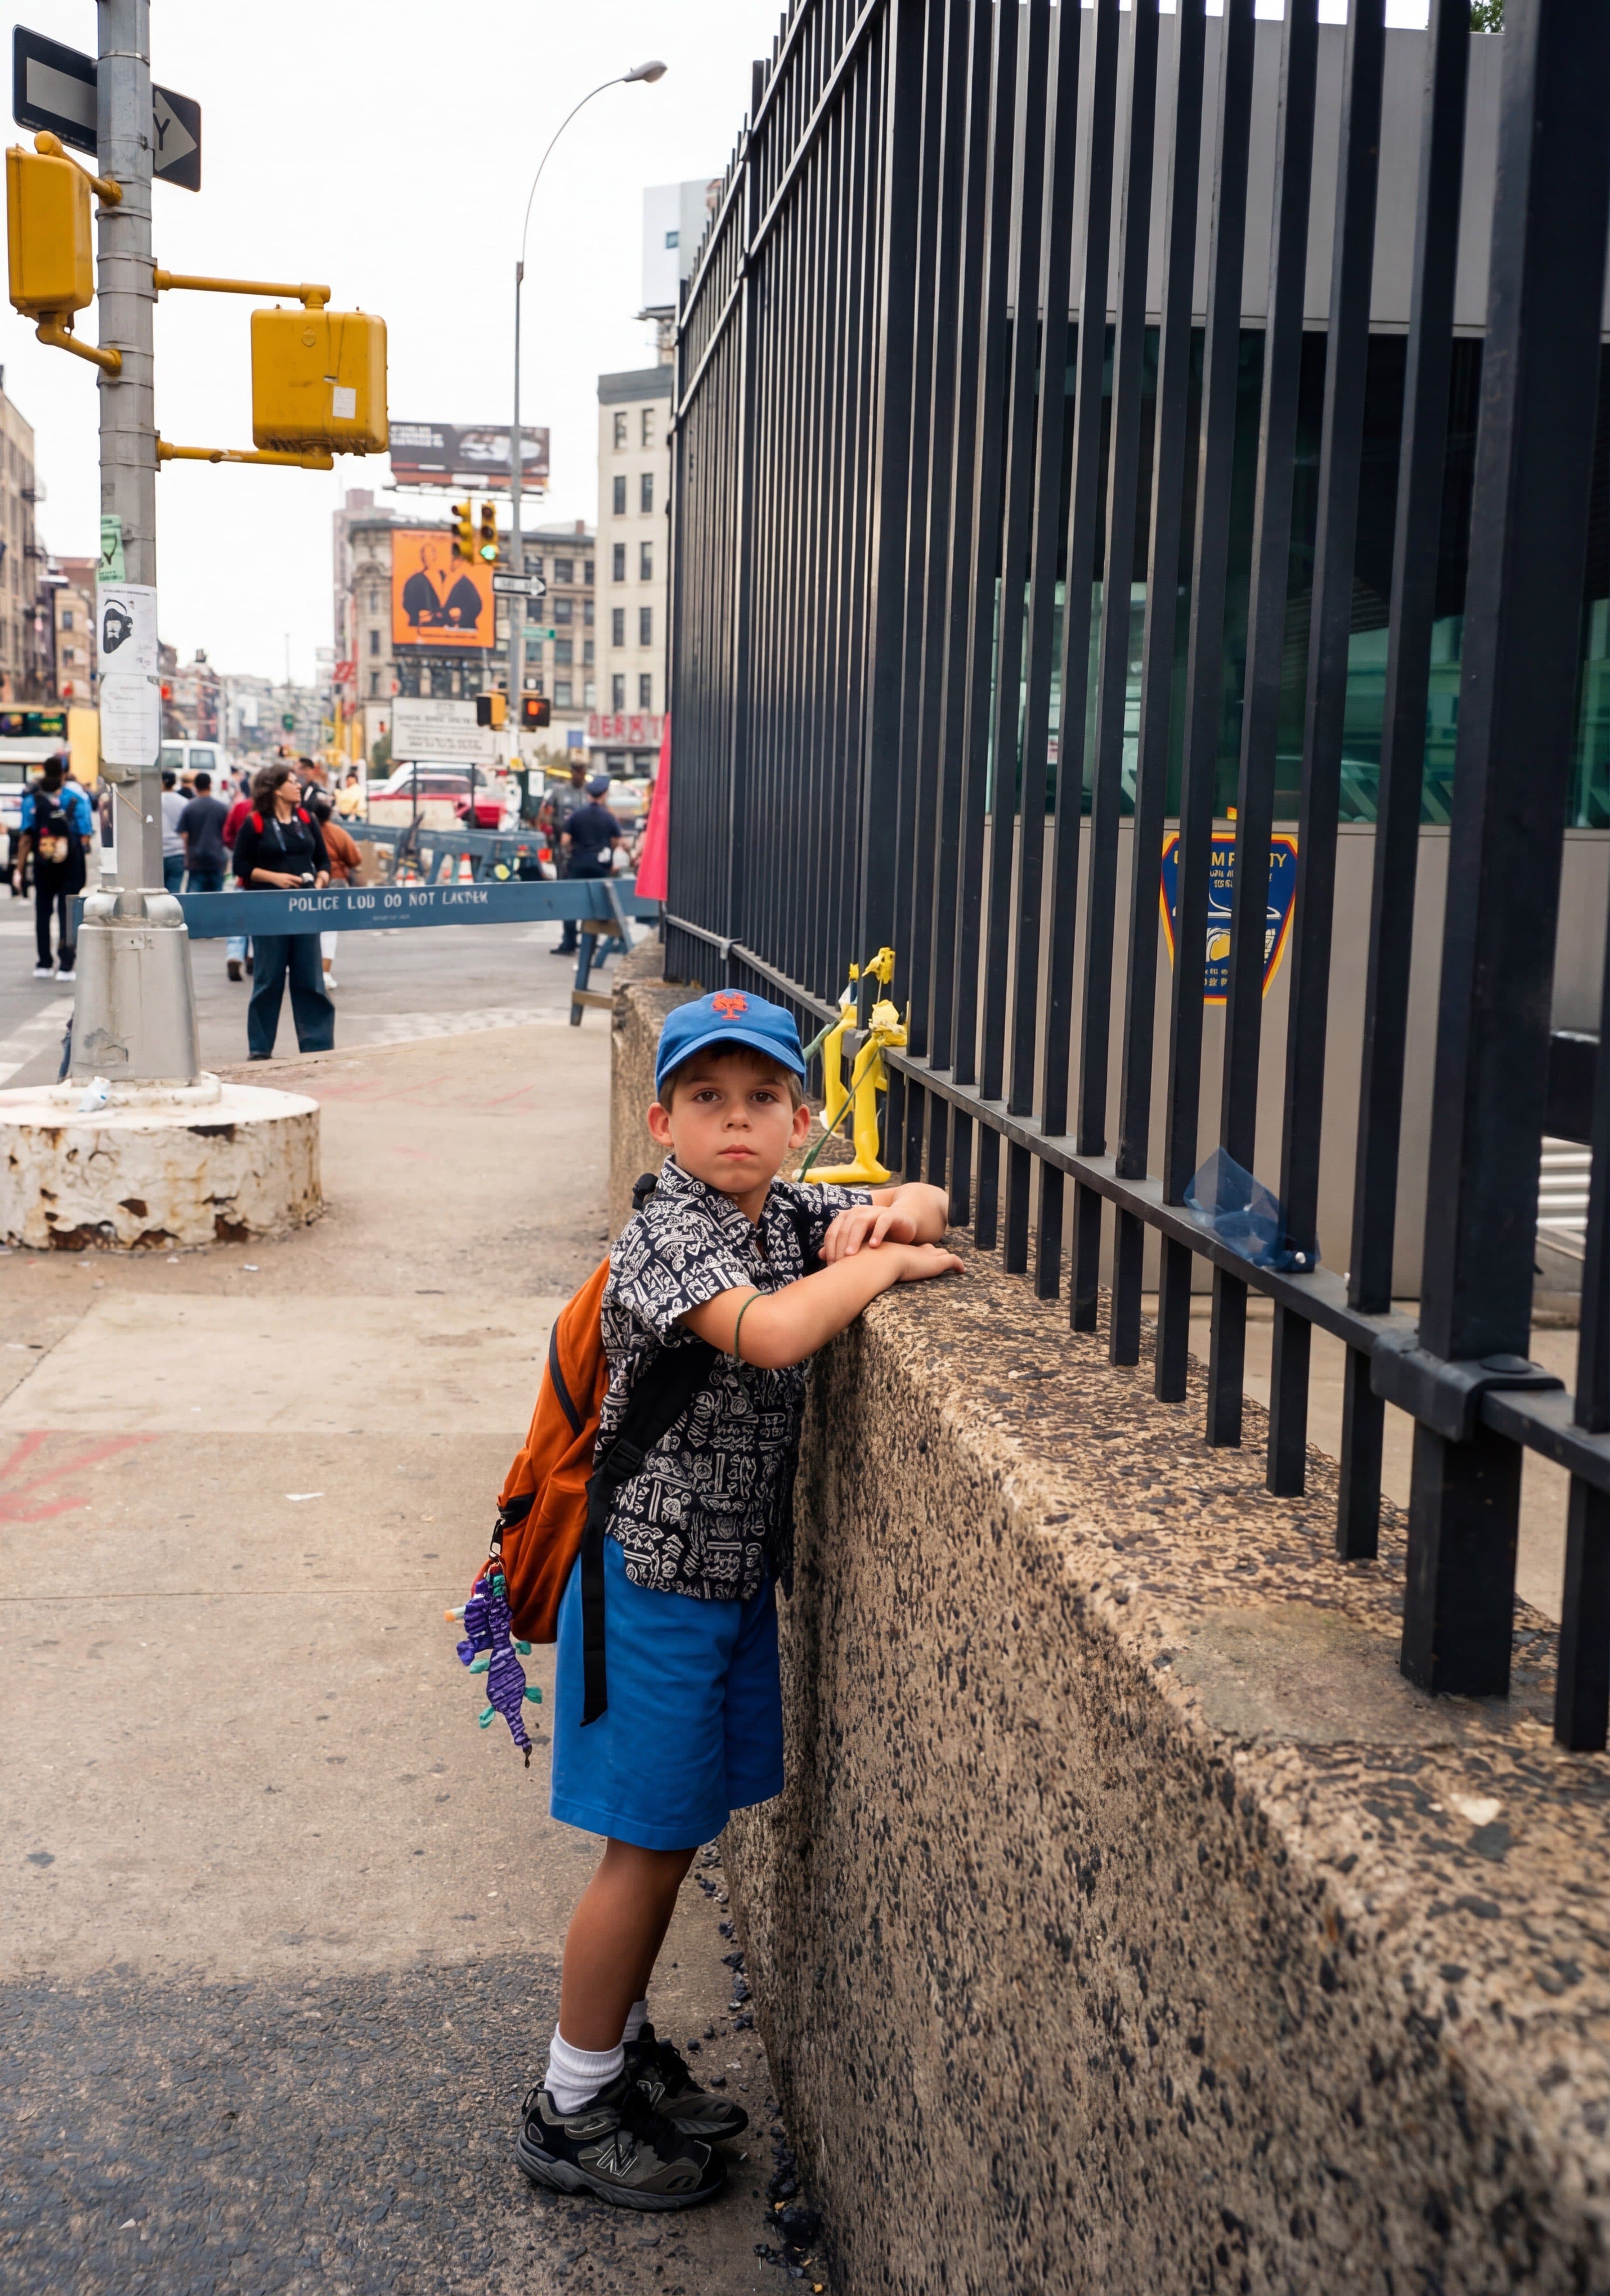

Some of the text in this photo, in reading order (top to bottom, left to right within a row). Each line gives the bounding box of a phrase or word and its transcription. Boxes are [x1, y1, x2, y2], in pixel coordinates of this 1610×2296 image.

[288, 896, 340, 912] POLICE
[409, 891, 436, 907] NOT
[597, 2143, 638, 2177] N
